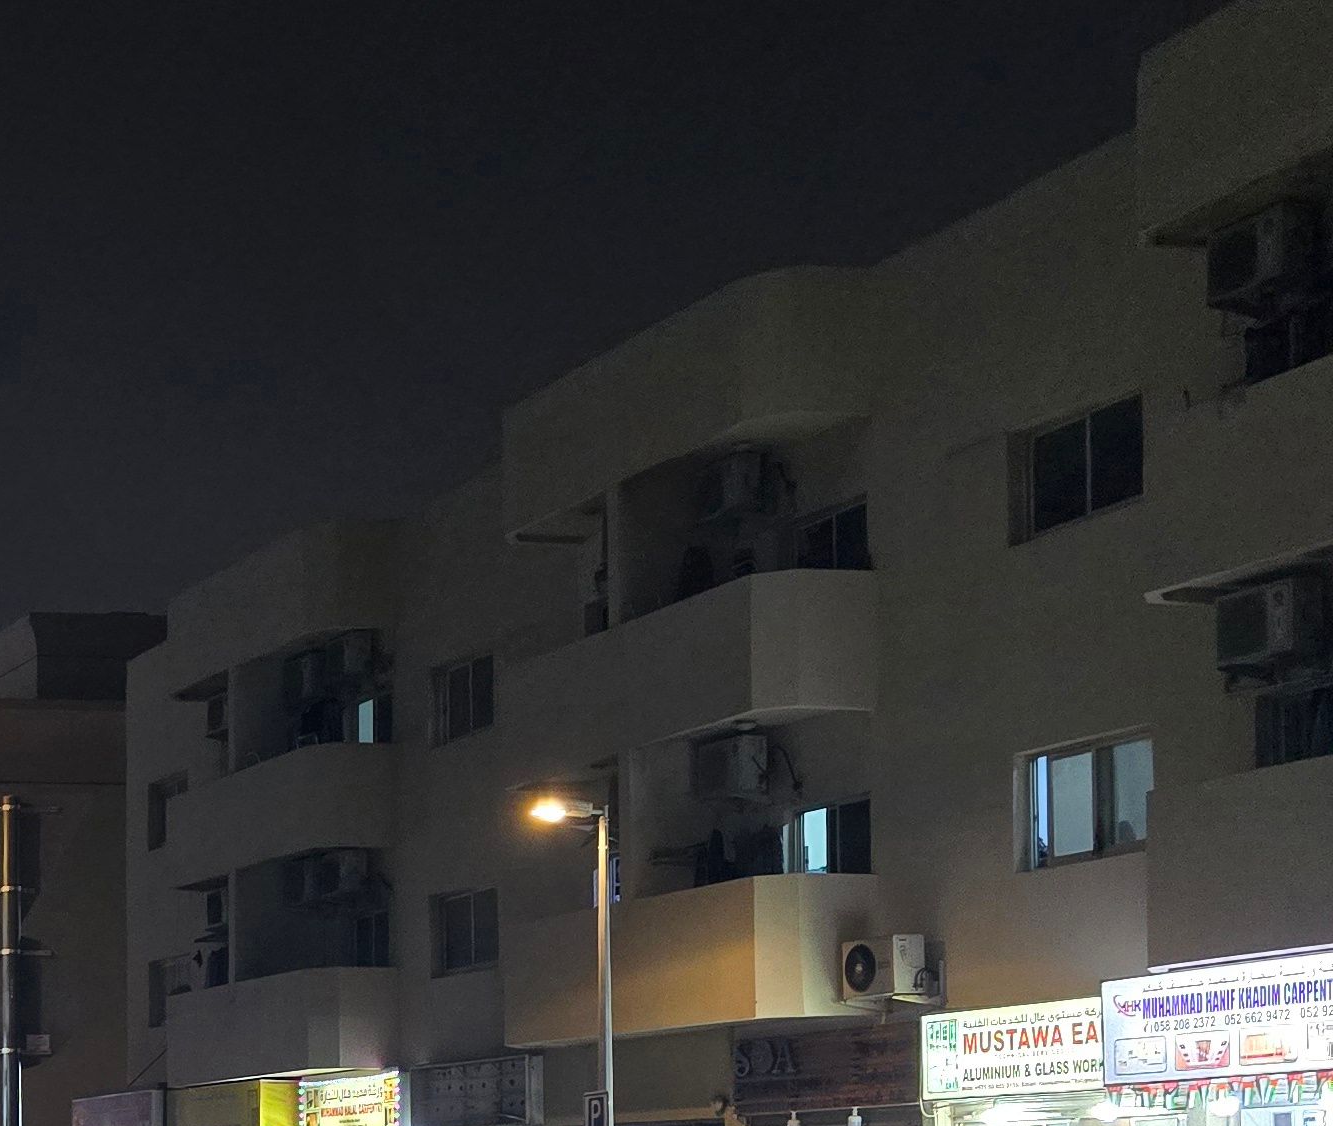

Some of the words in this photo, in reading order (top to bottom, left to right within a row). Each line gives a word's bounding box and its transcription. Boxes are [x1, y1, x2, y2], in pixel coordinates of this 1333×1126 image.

[1142, 992, 1203, 1019] MUHAMMAD
[1205, 988, 1236, 1013] HANIF
[1238, 983, 1281, 1009] KHADIM
[1193, 1016, 1216, 1028] 2372
[1224, 1013, 1242, 1025] 052
[1245, 1011, 1263, 1023] 662
[1266, 1008, 1291, 1021] 9472
[1300, 1005, 1319, 1018] 052
[962, 1024, 1064, 1055] MUSTAWA
[962, 1063, 1021, 1082] ALUMINIUM
[1024, 1062, 1032, 1077] &
[1035, 1059, 1070, 1077] GLASS
